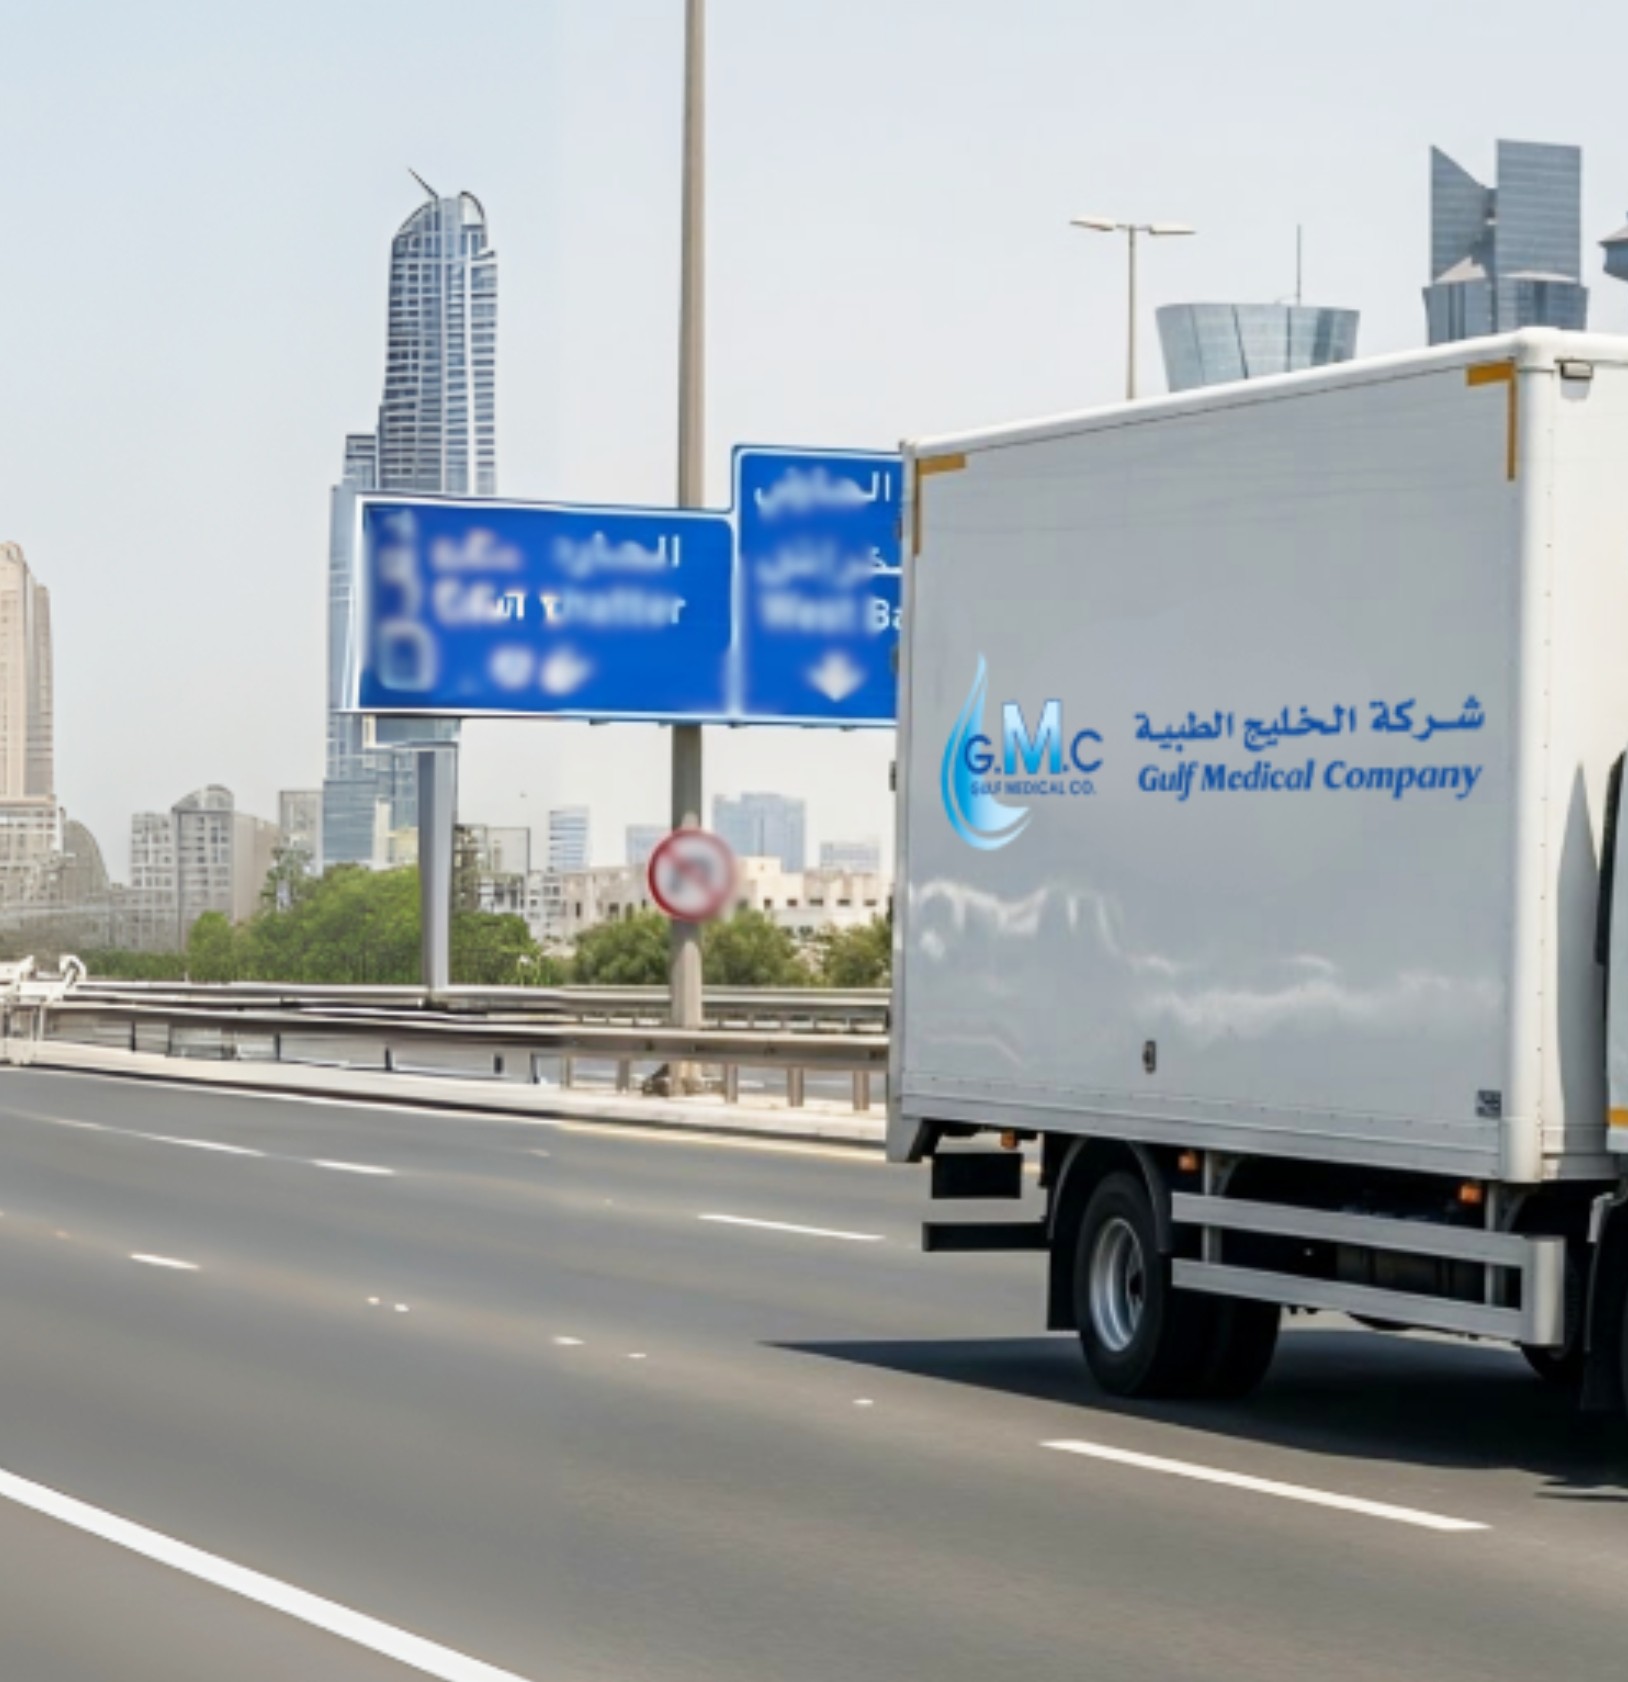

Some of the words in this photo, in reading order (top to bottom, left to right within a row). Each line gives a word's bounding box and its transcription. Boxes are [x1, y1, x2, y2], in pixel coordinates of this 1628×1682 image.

[964, 699, 1103, 776] G.M.C
[1134, 710, 1234, 753] الطبية
[1243, 704, 1357, 753] الخليج
[1369, 695, 1485, 742] شركة
[1138, 761, 1198, 801] Gulf
[1202, 759, 1315, 792] Medical
[1323, 760, 1482, 800] Company
